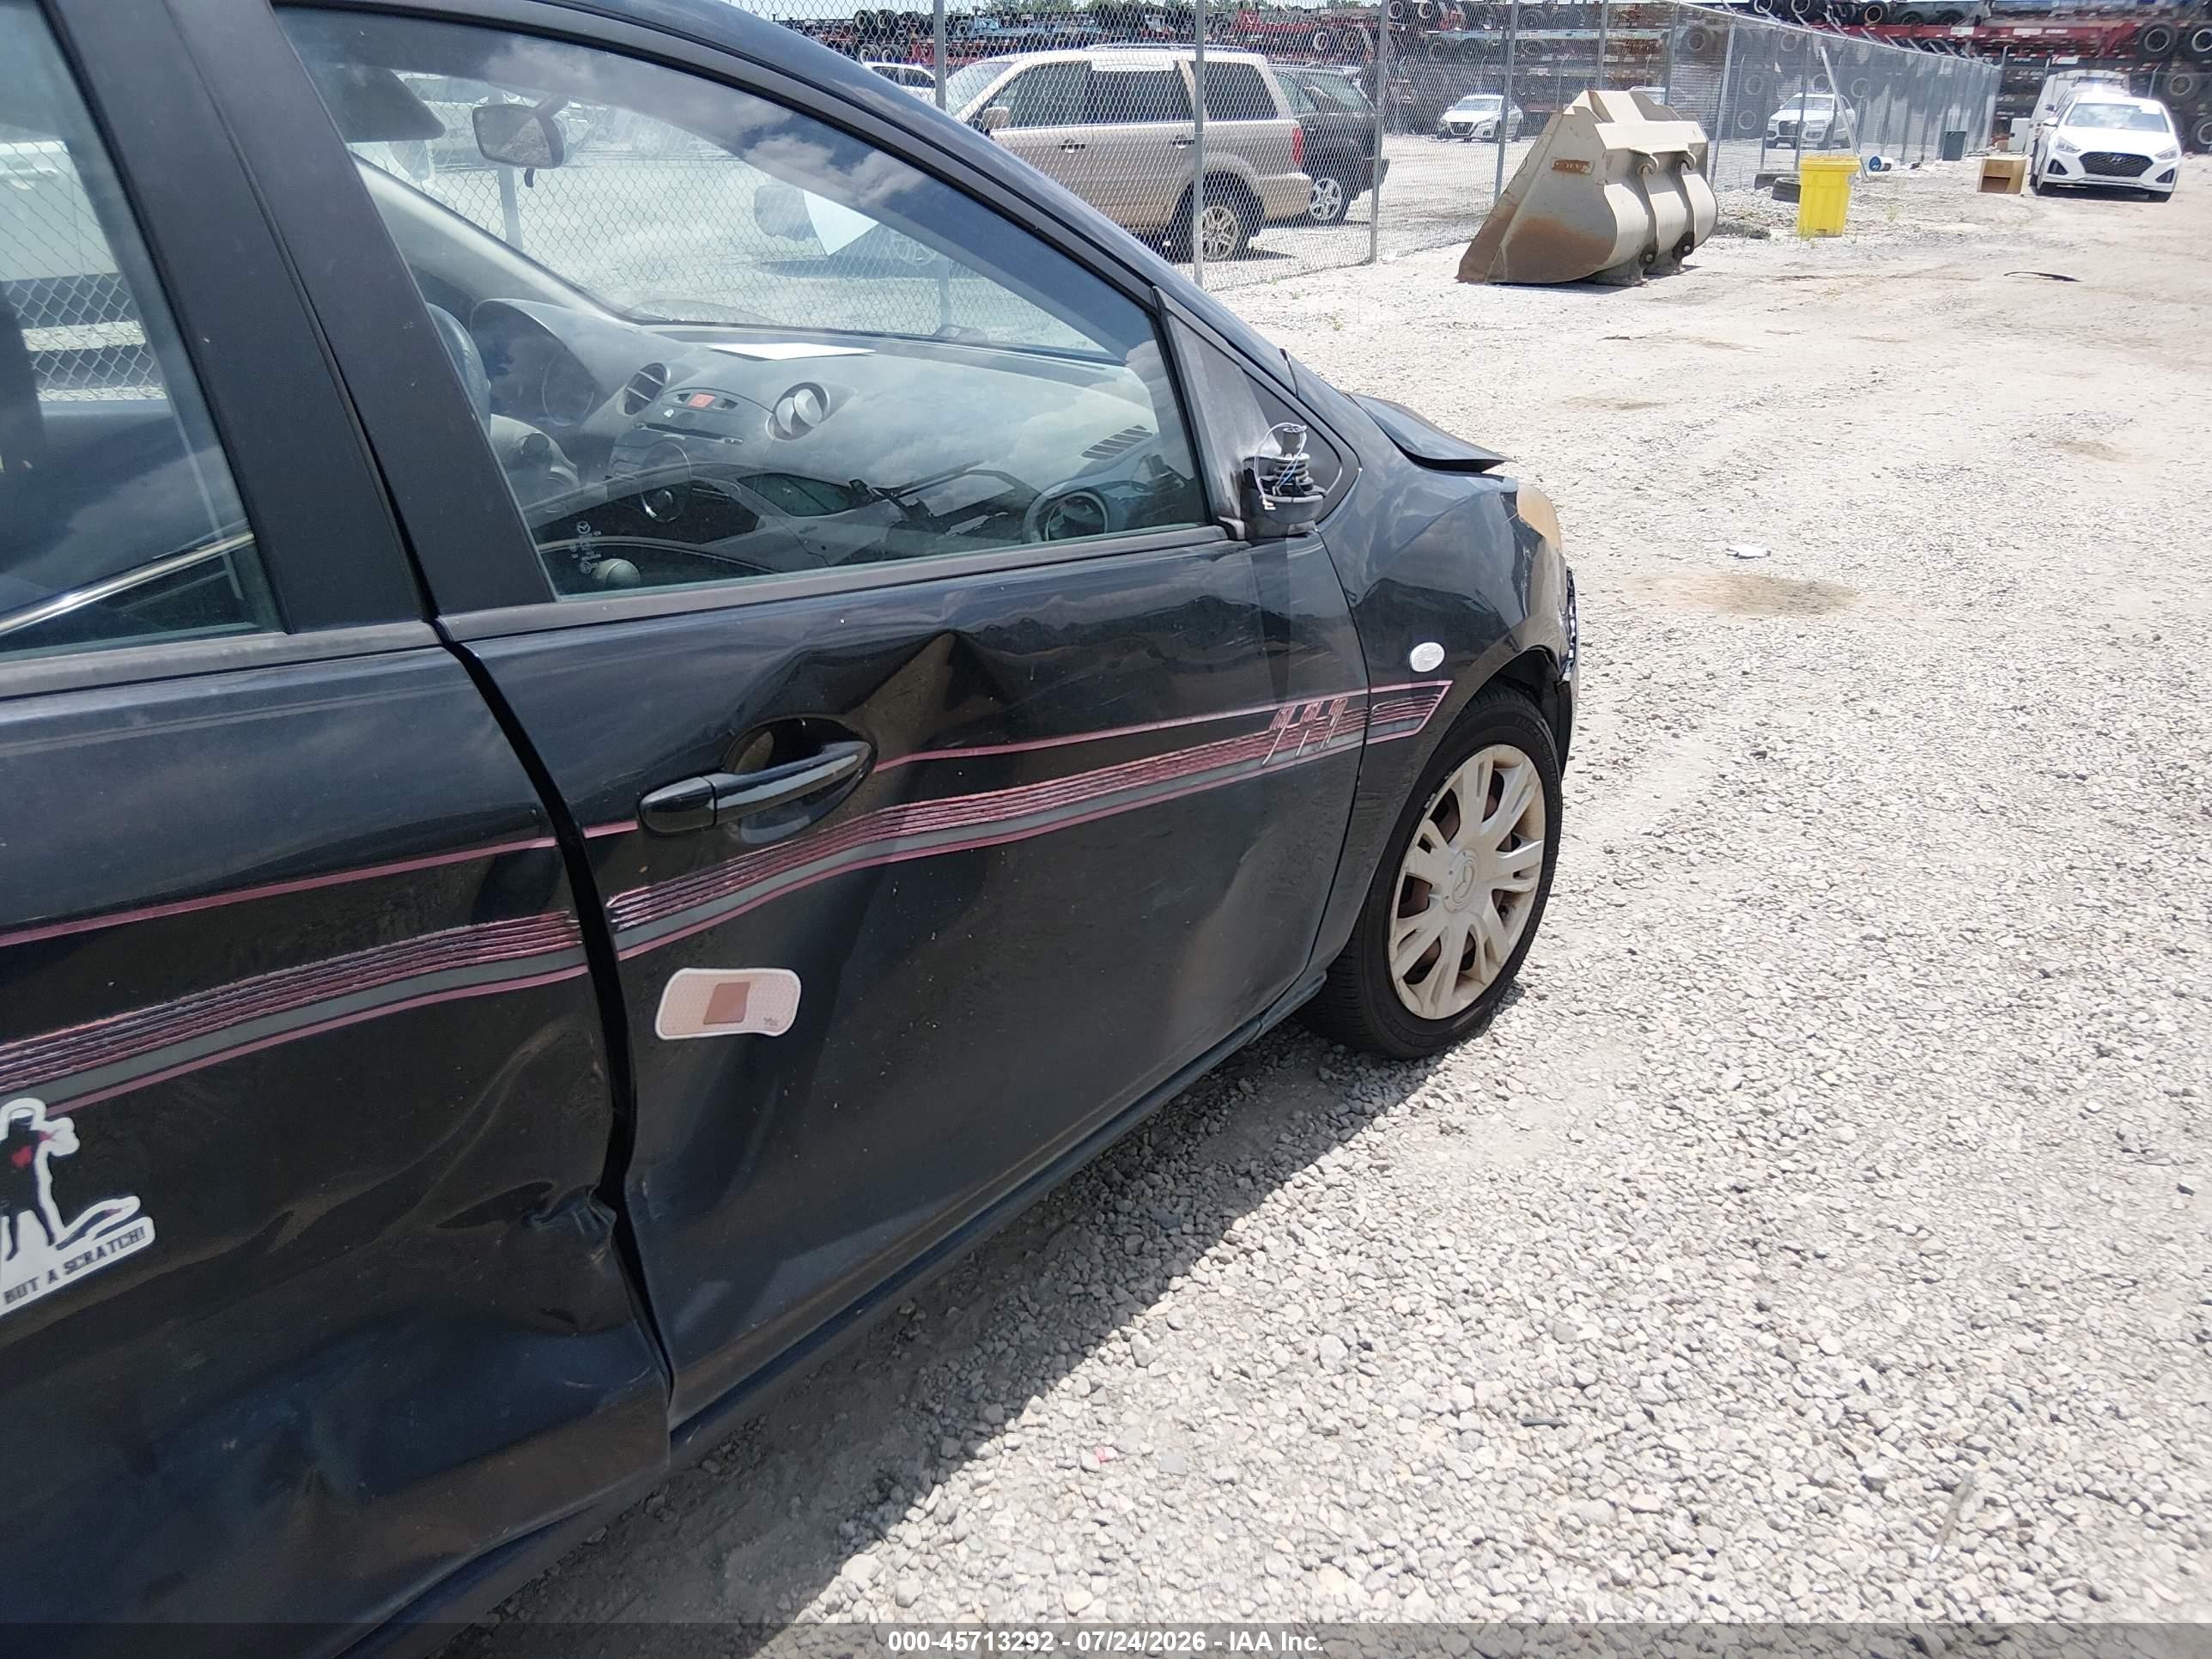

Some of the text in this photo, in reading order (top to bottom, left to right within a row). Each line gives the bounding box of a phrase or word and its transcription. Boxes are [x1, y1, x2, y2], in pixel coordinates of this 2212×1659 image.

[3, 1226, 146, 1304] BUT A SCRATCH!
